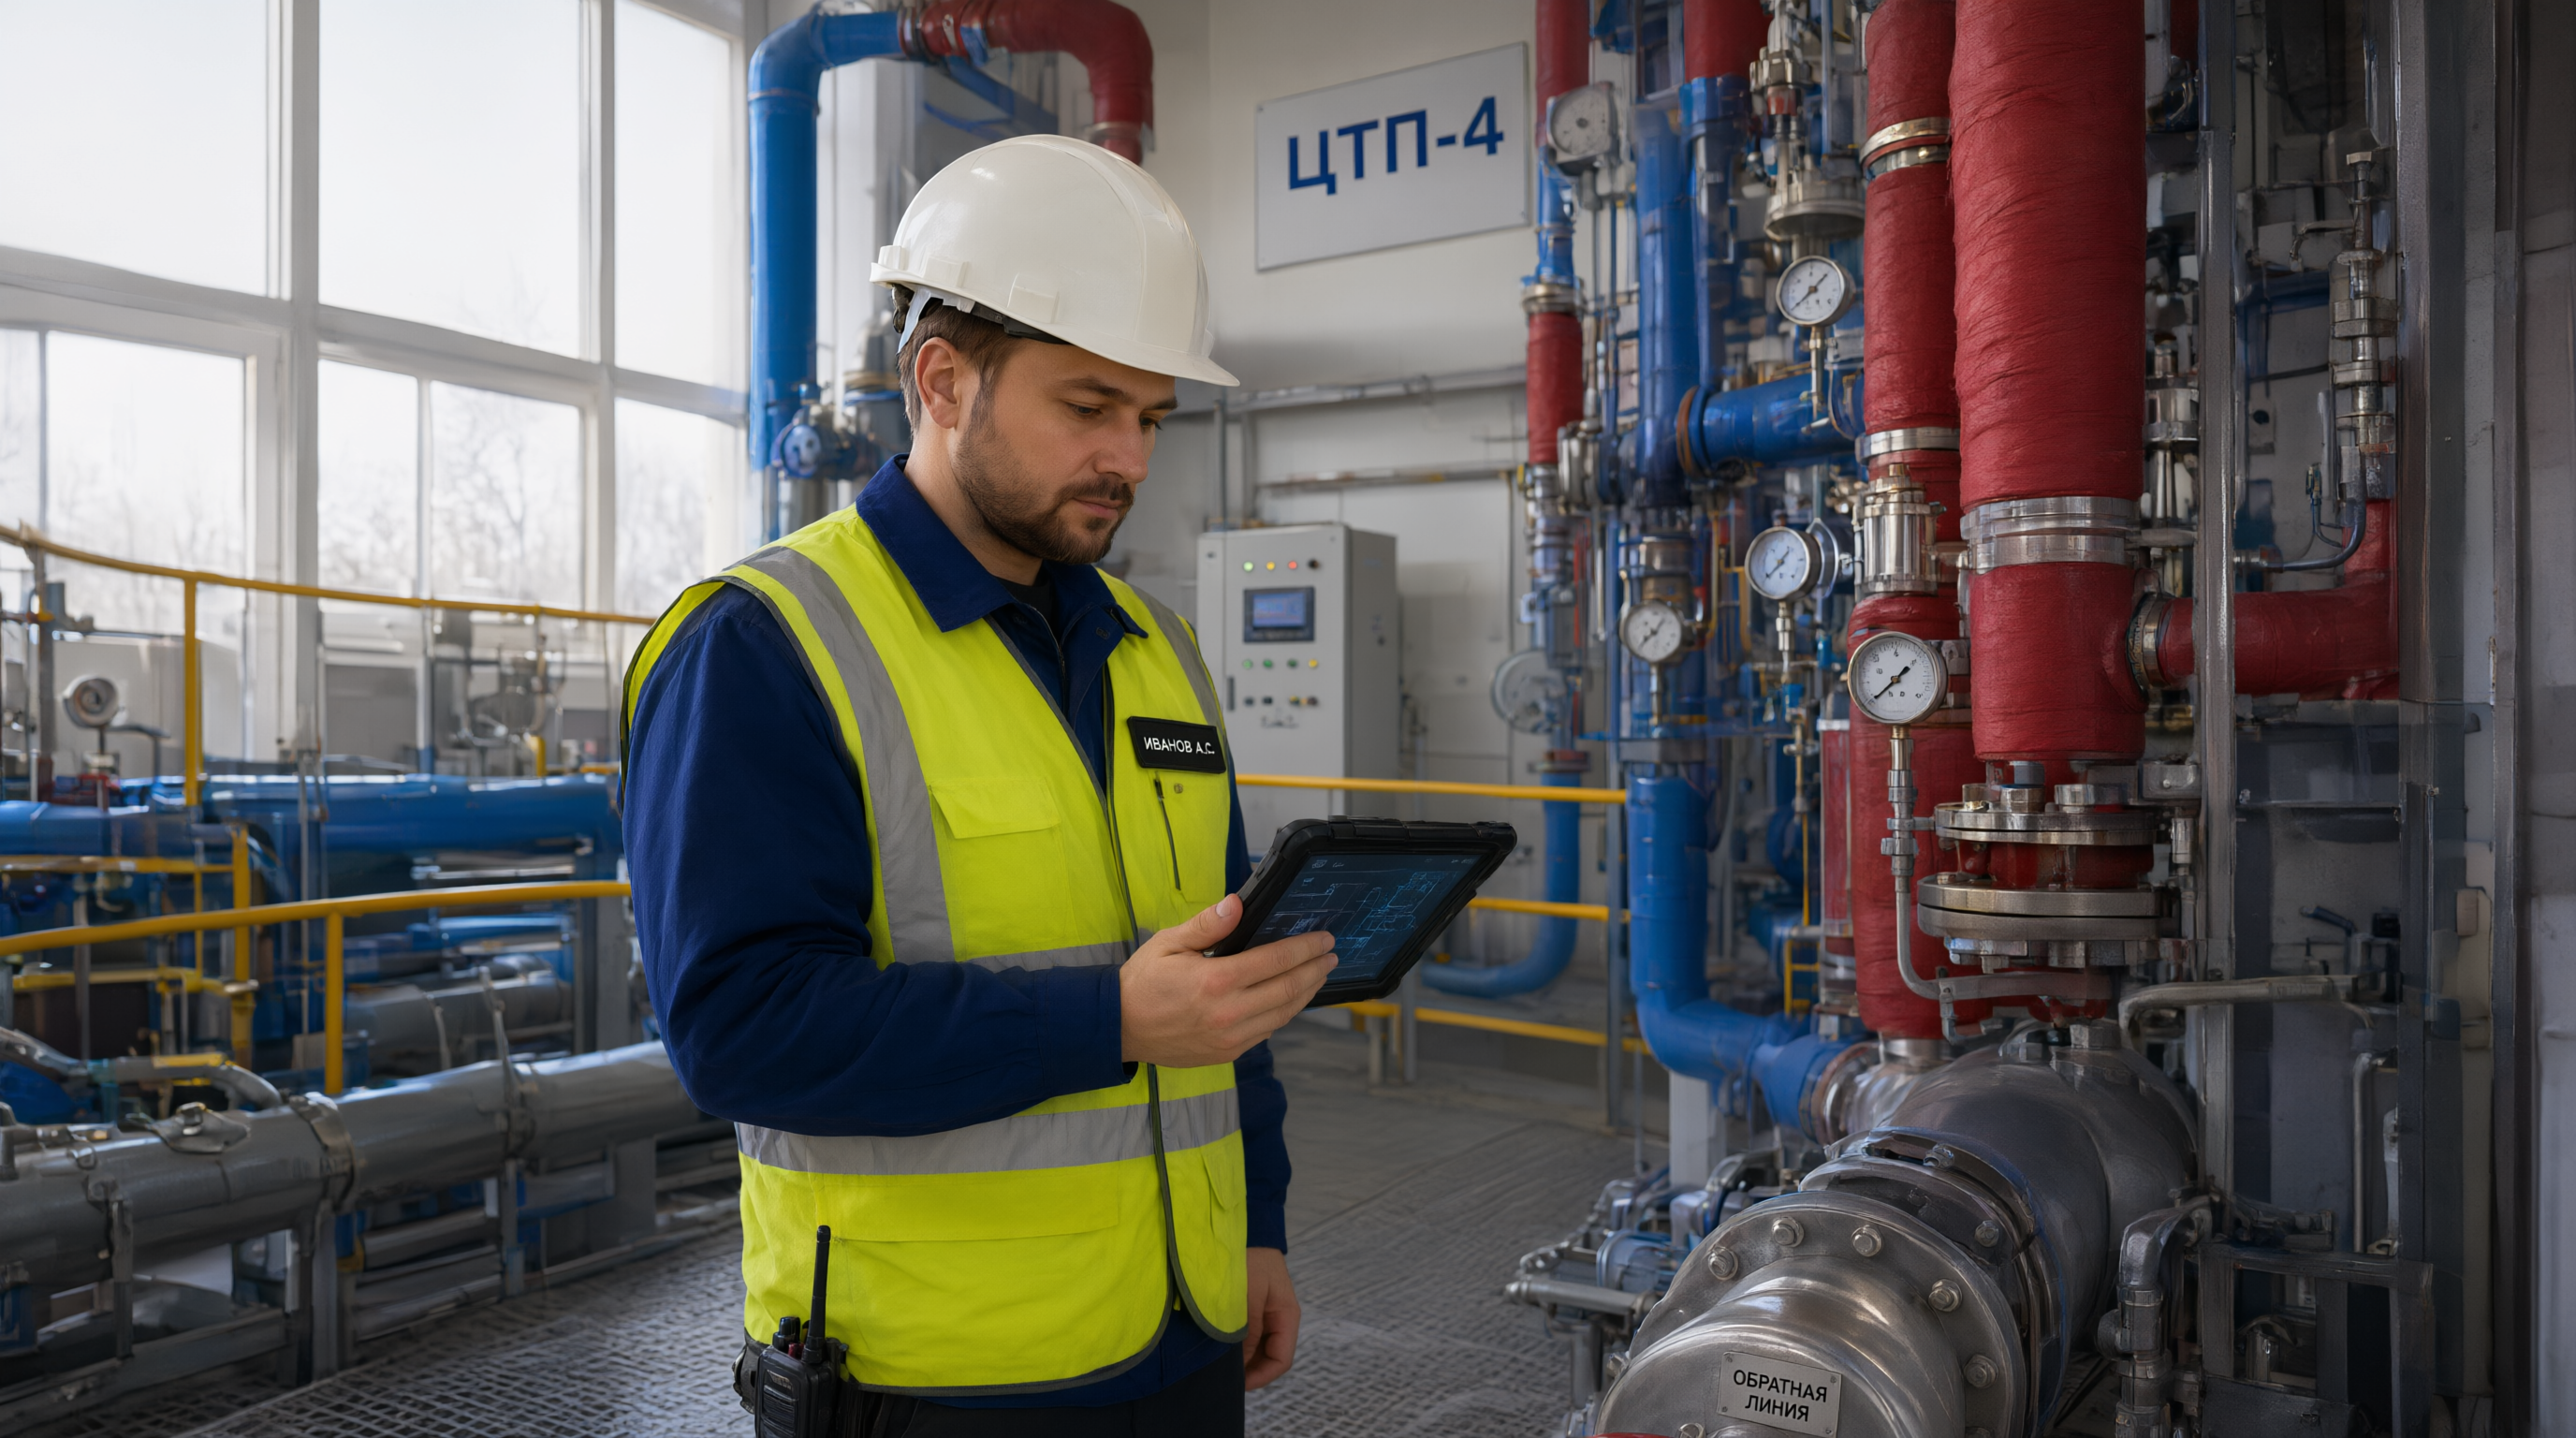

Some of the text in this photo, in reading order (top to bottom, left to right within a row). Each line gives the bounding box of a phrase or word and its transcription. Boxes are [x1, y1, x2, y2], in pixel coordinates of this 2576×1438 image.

[1288, 95, 1504, 196] ЦТП-4
[1144, 737, 1193, 753] ИВАНОВ
[1734, 1370, 1827, 1402] ОБРАТНАЯ
[1745, 1395, 1809, 1422] ЛИНИЯ
